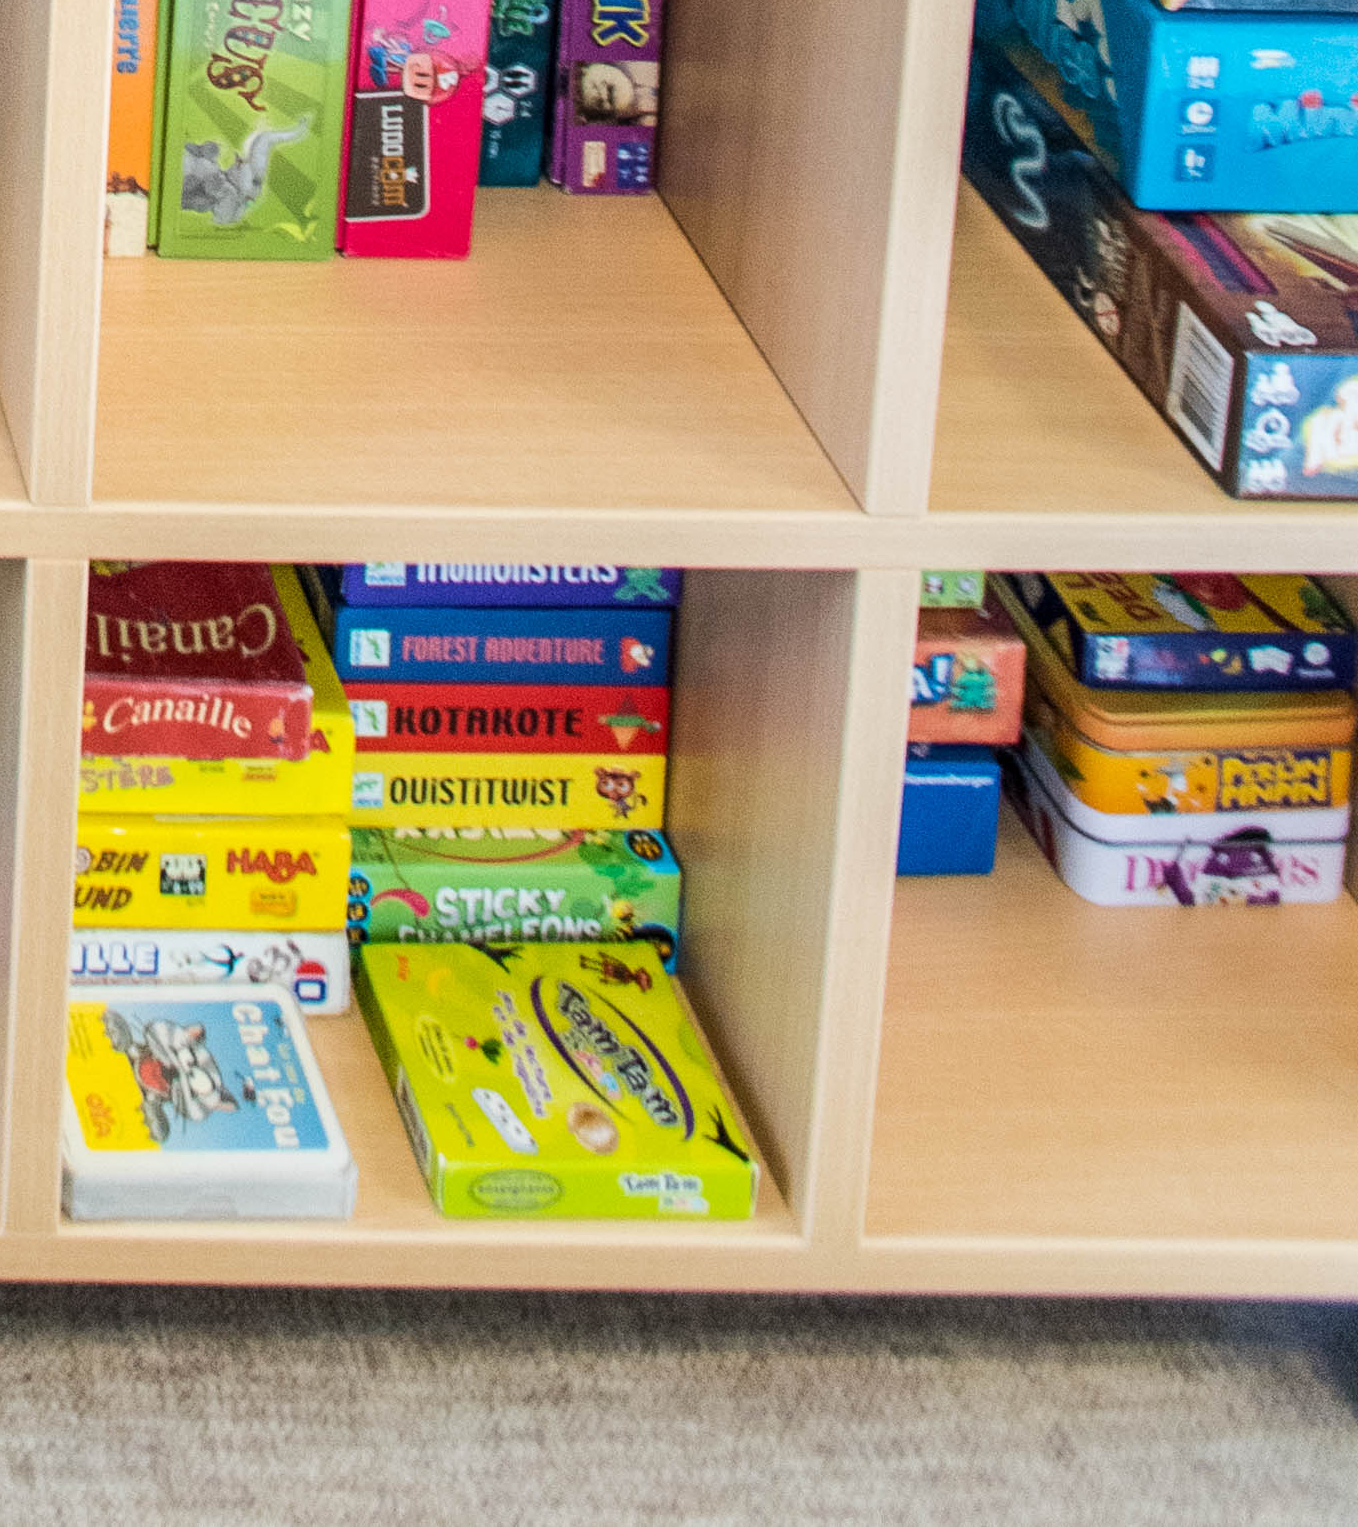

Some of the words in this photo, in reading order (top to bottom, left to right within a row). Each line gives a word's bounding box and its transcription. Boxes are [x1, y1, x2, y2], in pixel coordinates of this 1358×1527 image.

[402, 638, 479, 663] FOREST
[485, 639, 605, 665] ADVENTURE
[102, 694, 254, 739] Canaille
[394, 706, 584, 739] KOTAKOTE
[226, 849, 319, 883] HABA
[435, 887, 566, 922] STICKY
